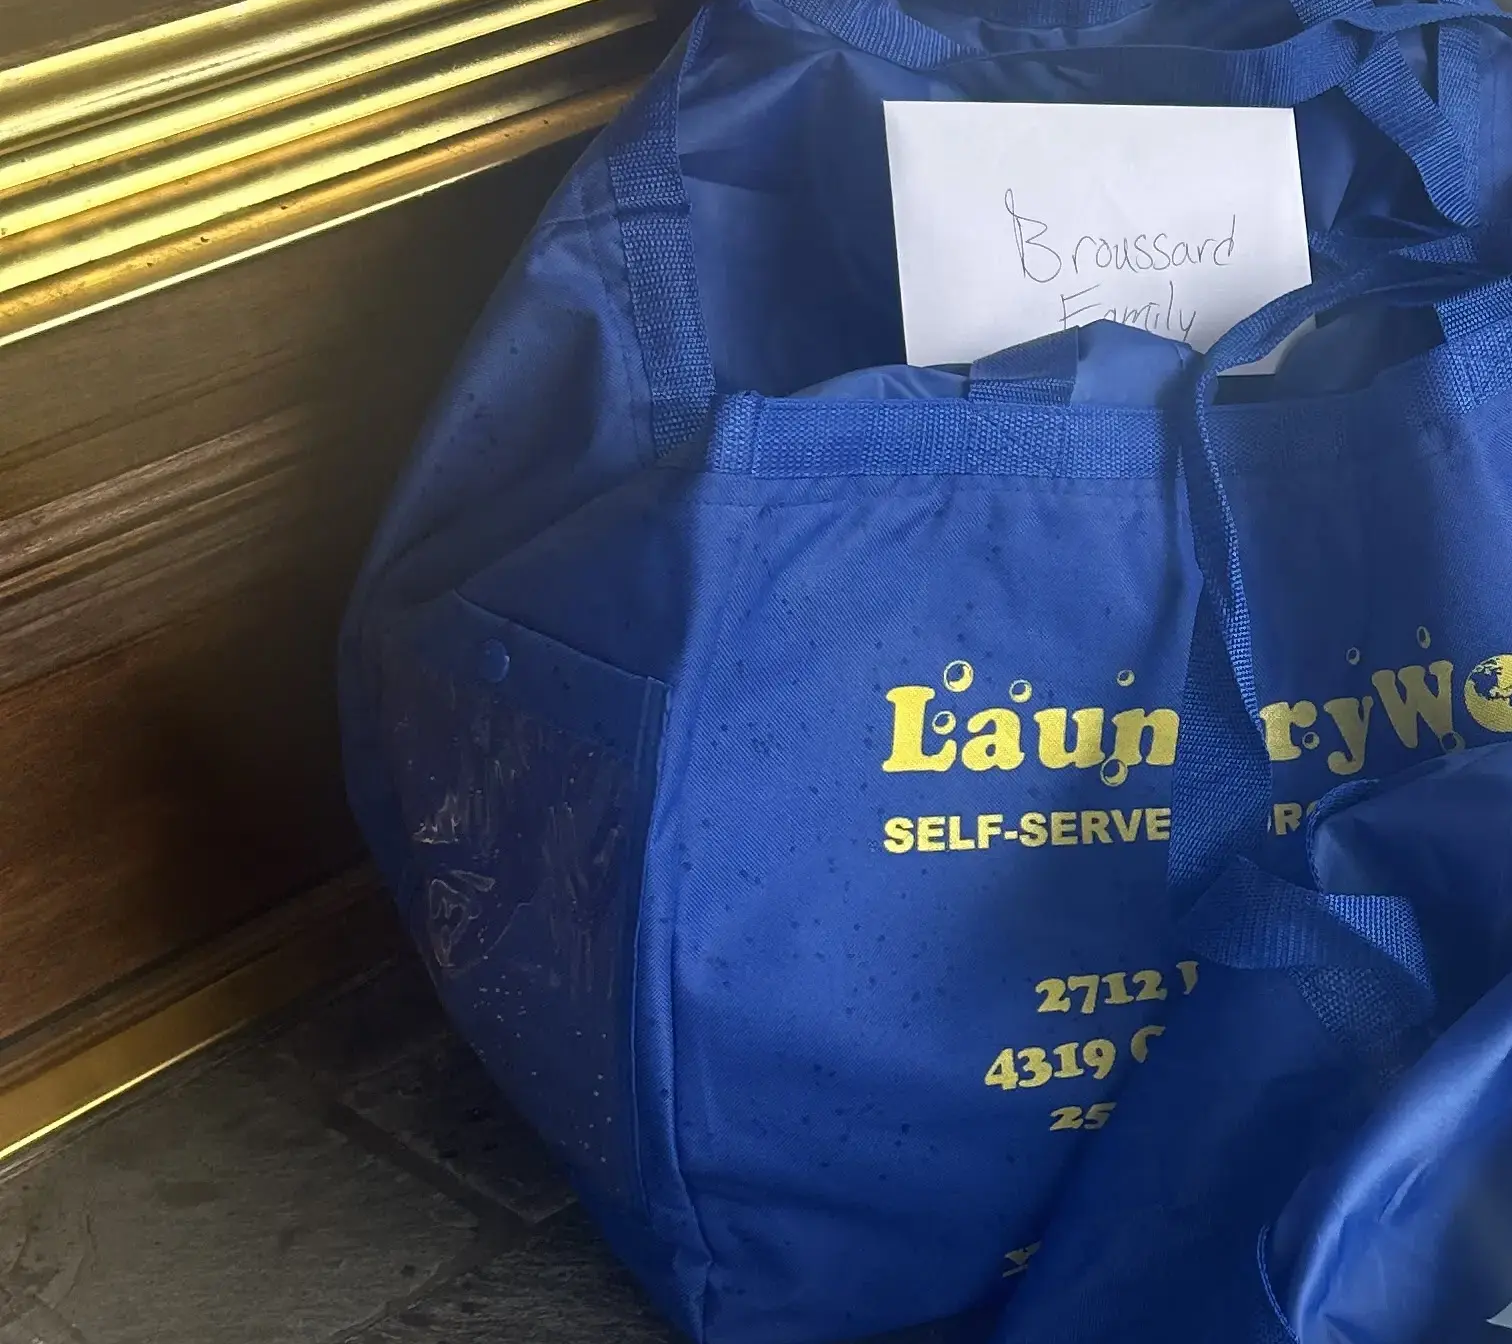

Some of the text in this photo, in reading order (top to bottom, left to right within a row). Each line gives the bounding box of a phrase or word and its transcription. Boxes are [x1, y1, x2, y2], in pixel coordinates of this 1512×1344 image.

[1004, 188, 1236, 283] Broussard
[883, 807, 1172, 854] SELF-SERVE
[1035, 970, 1168, 1014] 2712
[984, 1039, 1117, 1090] 4319
